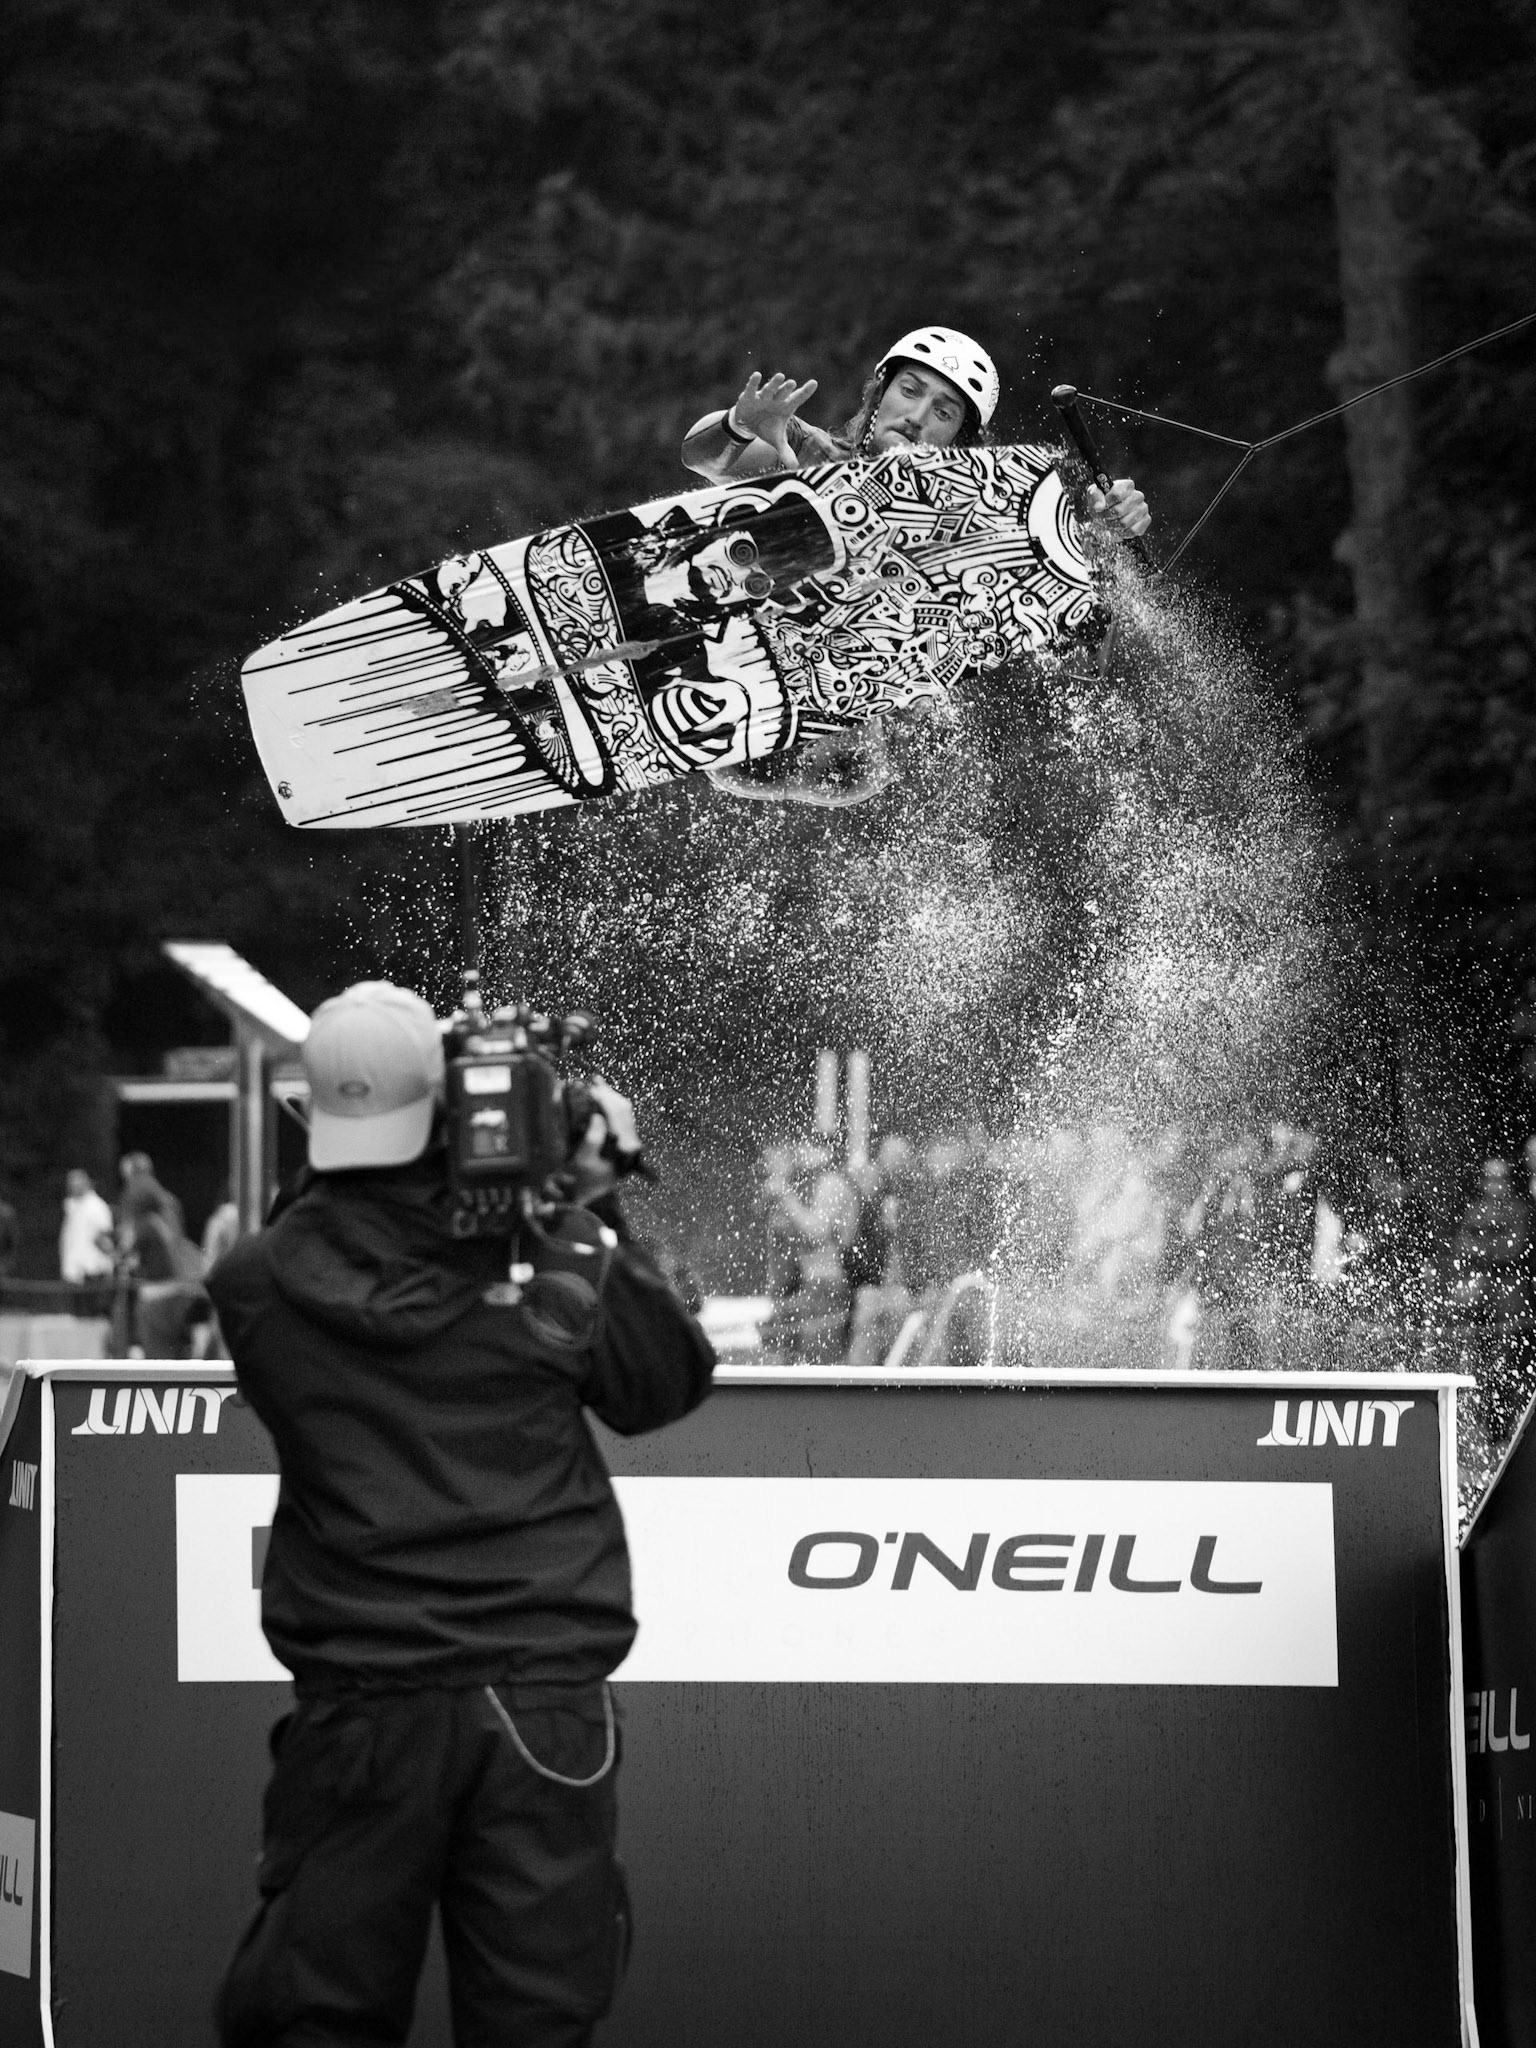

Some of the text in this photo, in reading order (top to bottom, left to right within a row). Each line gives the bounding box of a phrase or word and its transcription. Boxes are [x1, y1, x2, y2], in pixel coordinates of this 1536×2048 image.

[71, 1388, 237, 1435] UNIT
[1257, 1400, 1415, 1447] UNIT
[9, 1459, 38, 1511] UNIT
[787, 1531, 1263, 1595] O'NEILL
